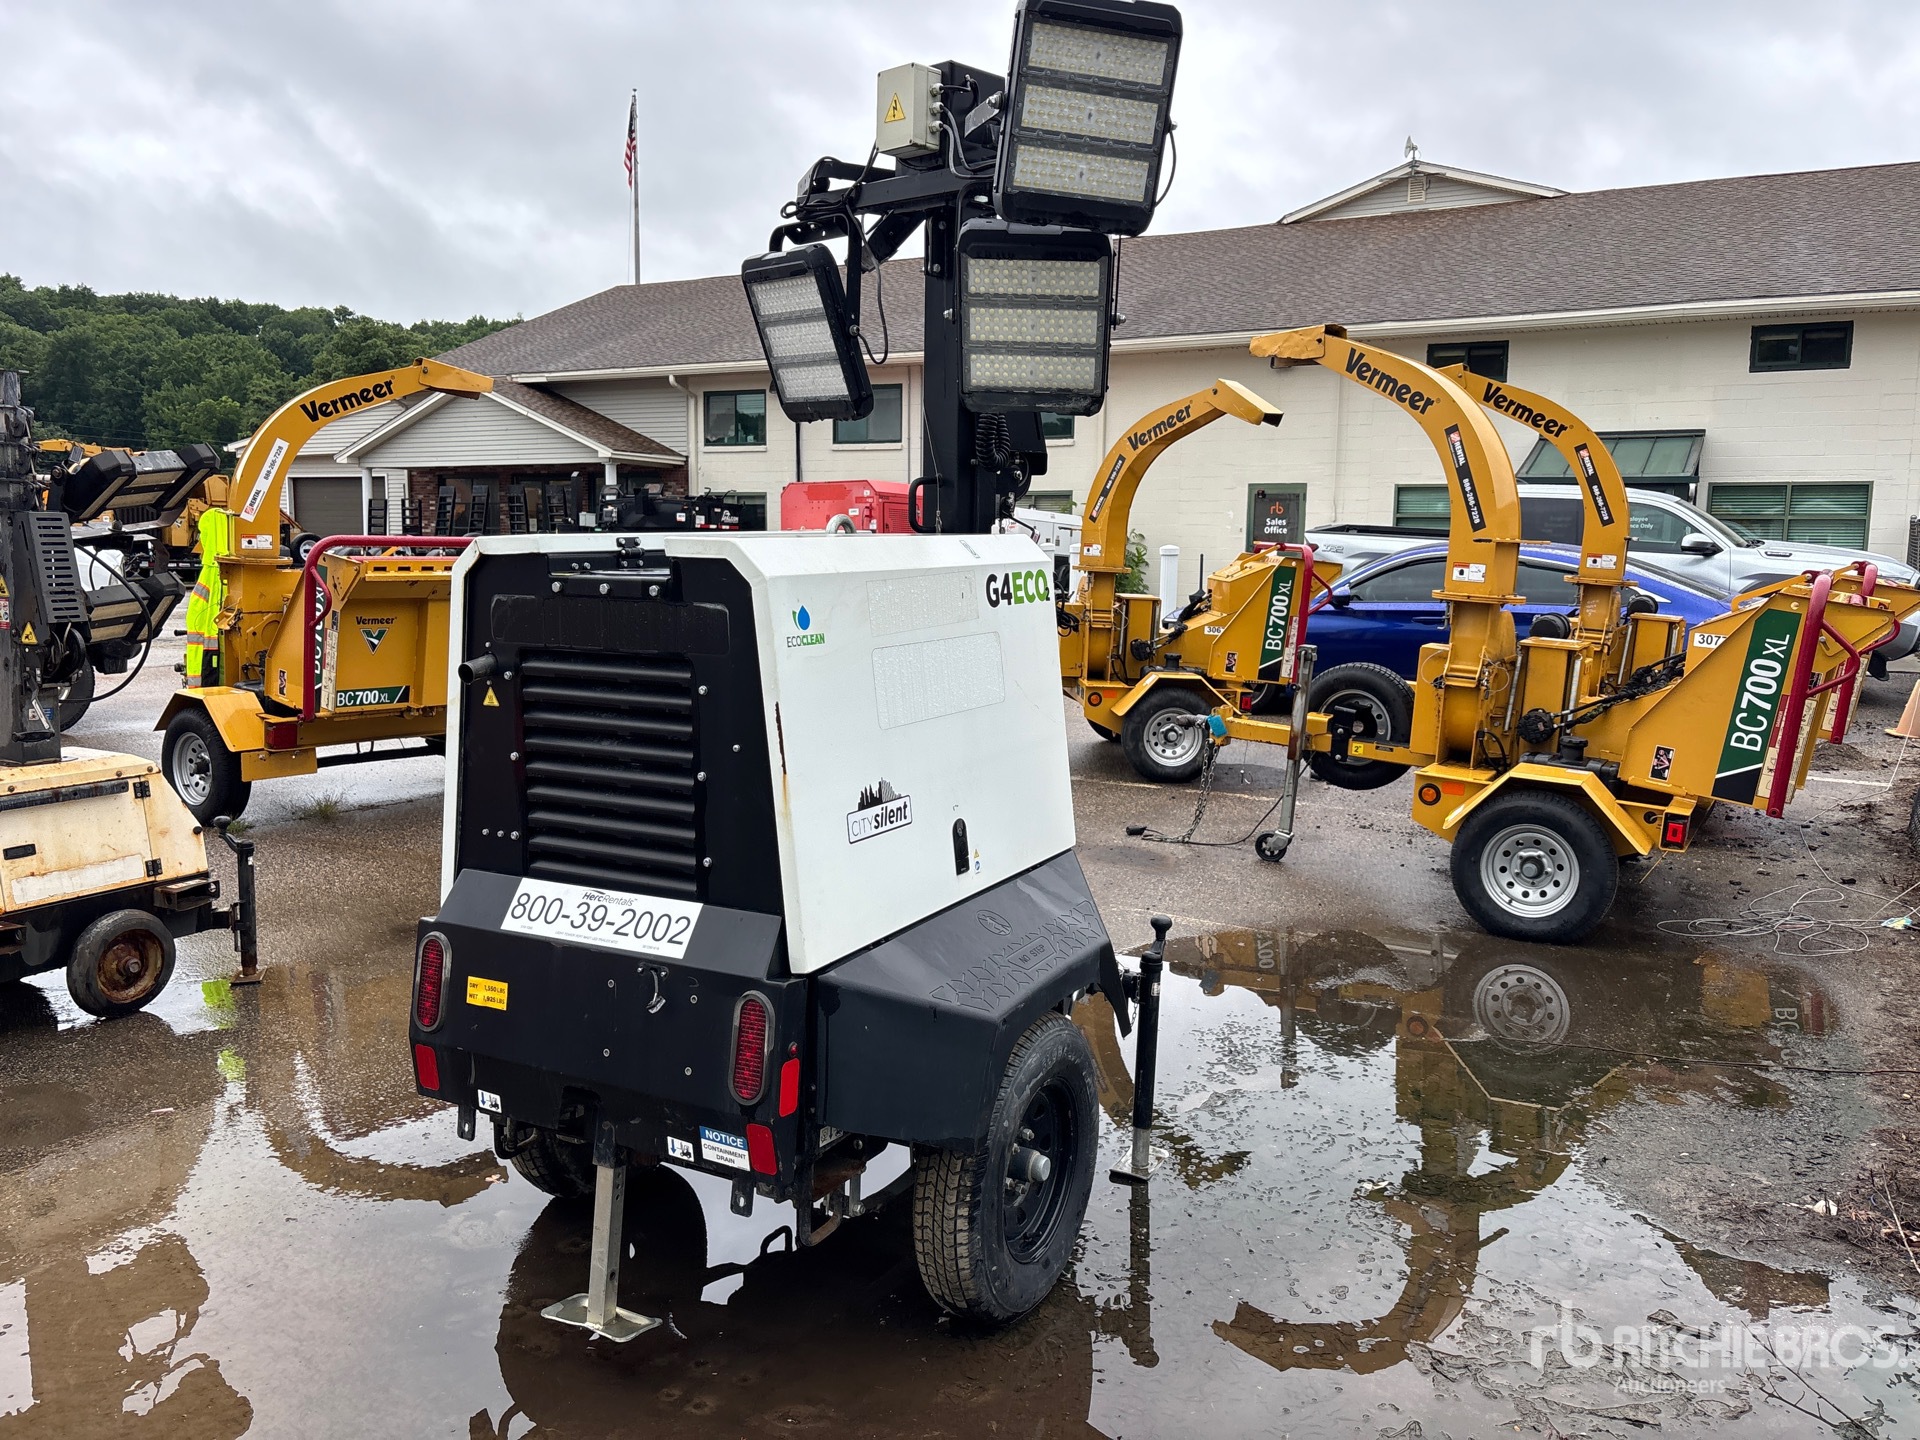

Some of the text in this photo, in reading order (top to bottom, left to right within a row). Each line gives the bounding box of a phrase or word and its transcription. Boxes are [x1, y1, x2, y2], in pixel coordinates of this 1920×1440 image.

[1345, 347, 1435, 415] Vermeer
[300, 379, 394, 423] Vermeer
[1482, 382, 1568, 438] Vermeer
[1127, 404, 1192, 452] Vermeer
[1454, 441, 1467, 467] RENTAL
[1583, 456, 1595, 476] RENTAL
[249, 489, 262, 507] RENTAL
[1264, 526, 1288, 534] Office
[1266, 518, 1287, 526] Sales
[356, 616, 394, 625] Vermeer
[1206, 626, 1225, 634] 306
[786, 633, 825, 648] ECOCLEAN
[1698, 633, 1727, 646] 307
[851, 801, 908, 838] CITYsilent
[582, 891, 635, 907] HercRentals
[511, 892, 691, 945] 800-39-2002
[1018, 944, 1045, 964] NO STEP
[705, 1129, 744, 1149] NOTICE
[703, 1143, 746, 1160] CONTAINMENT
[716, 1153, 735, 1164] DRAIN
